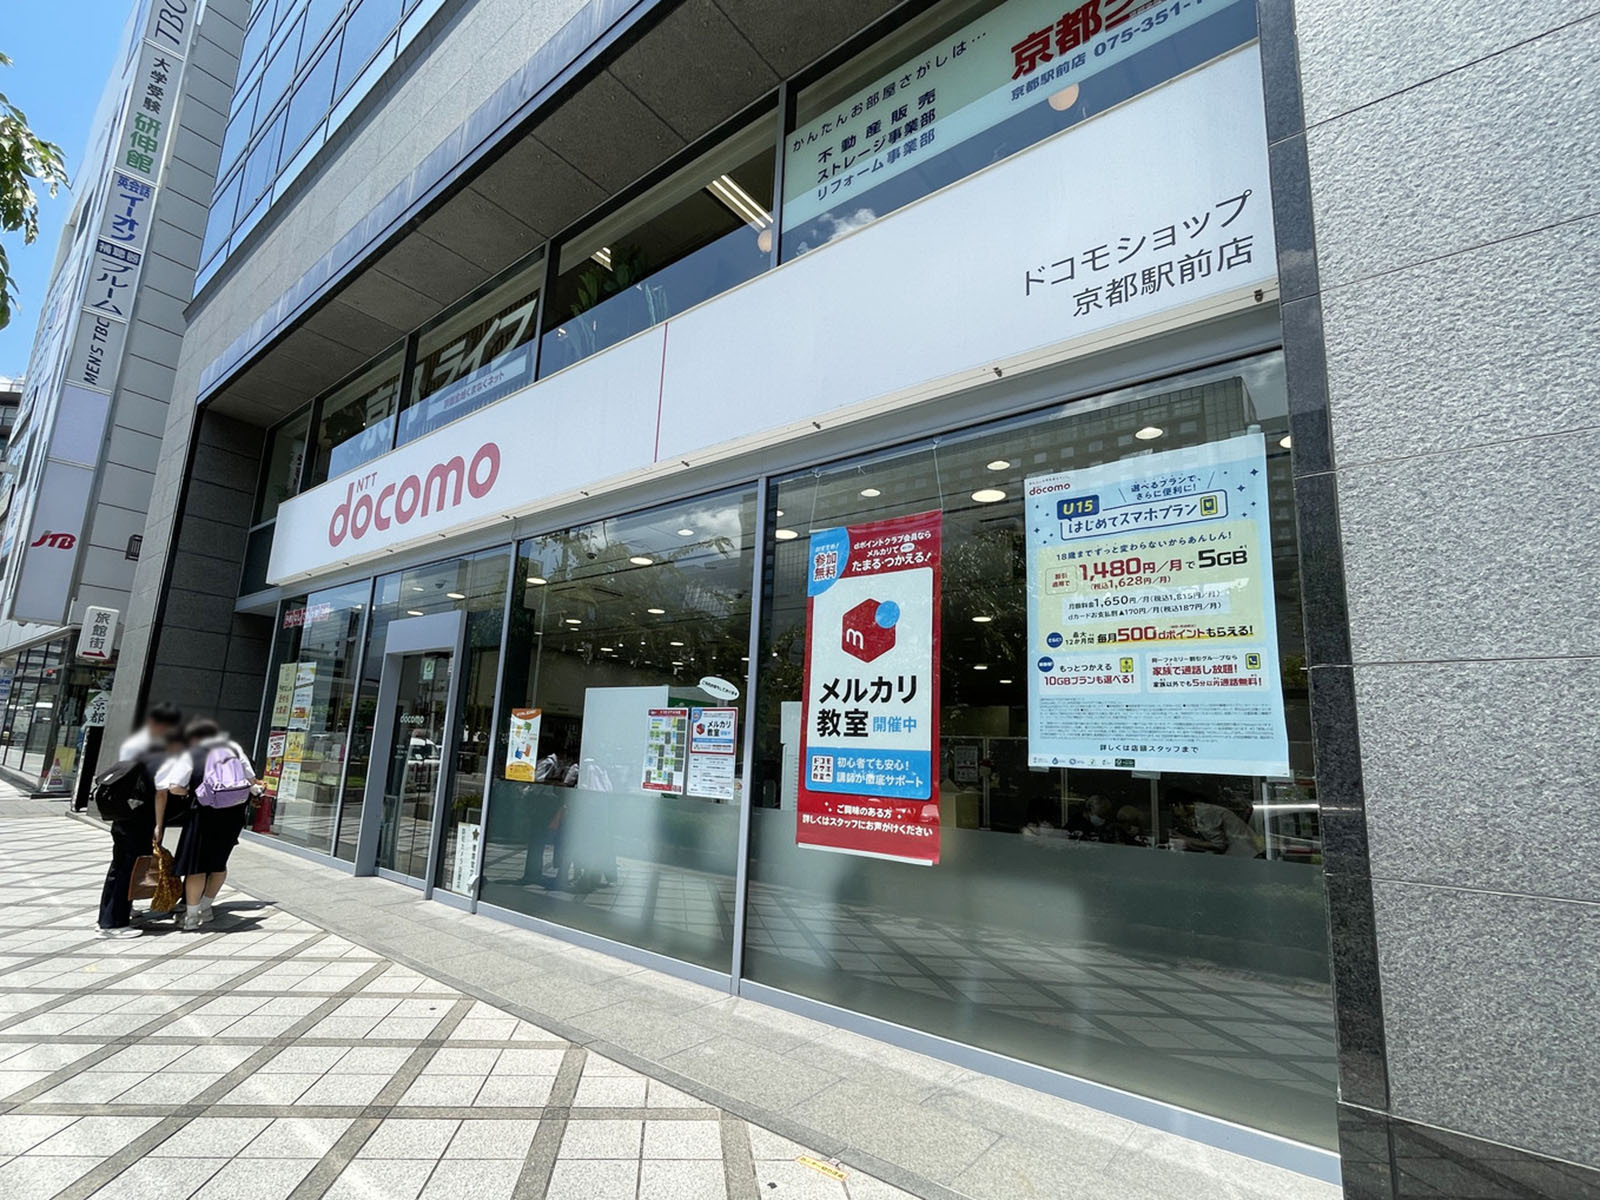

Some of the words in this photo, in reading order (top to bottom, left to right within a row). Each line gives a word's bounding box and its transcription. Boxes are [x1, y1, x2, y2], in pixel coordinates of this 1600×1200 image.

[1010, 52, 1086, 100] 京都駅前店
[1093, 0, 1201, 57] 075-351-
[142, 56, 171, 115] 大学受験
[817, 88, 937, 163] 不動産販売
[126, 111, 162, 175] 研伸館
[817, 108, 937, 183] ストレージ事業部
[817, 128, 936, 200] リフォーム事業部
[117, 175, 151, 199] 英会話
[110, 193, 144, 243] イーオン
[1025, 188, 1253, 296] ドコモショップ
[1073, 235, 1254, 317] 京都駅前店
[83, 345, 104, 386] MEN'S
[94, 320, 110, 343] TBC
[328, 442, 501, 547] docomo
[356, 472, 378, 493] NTT
[1029, 483, 1071, 496] docomo
[1136, 484, 1197, 500] さらに便利に!
[1063, 500, 1093, 515] U15
[1068, 503, 1198, 534] はじめてスマホプラン
[31, 530, 77, 550] JTB
[813, 565, 837, 581] 無料
[814, 551, 838, 567] 参加
[818, 675, 917, 704] メルカリ
[707, 721, 732, 729] メルカリ
[817, 708, 869, 738] 教室
[872, 716, 917, 733] 開催中
[836, 757, 910, 771] 初心者でも安心!
